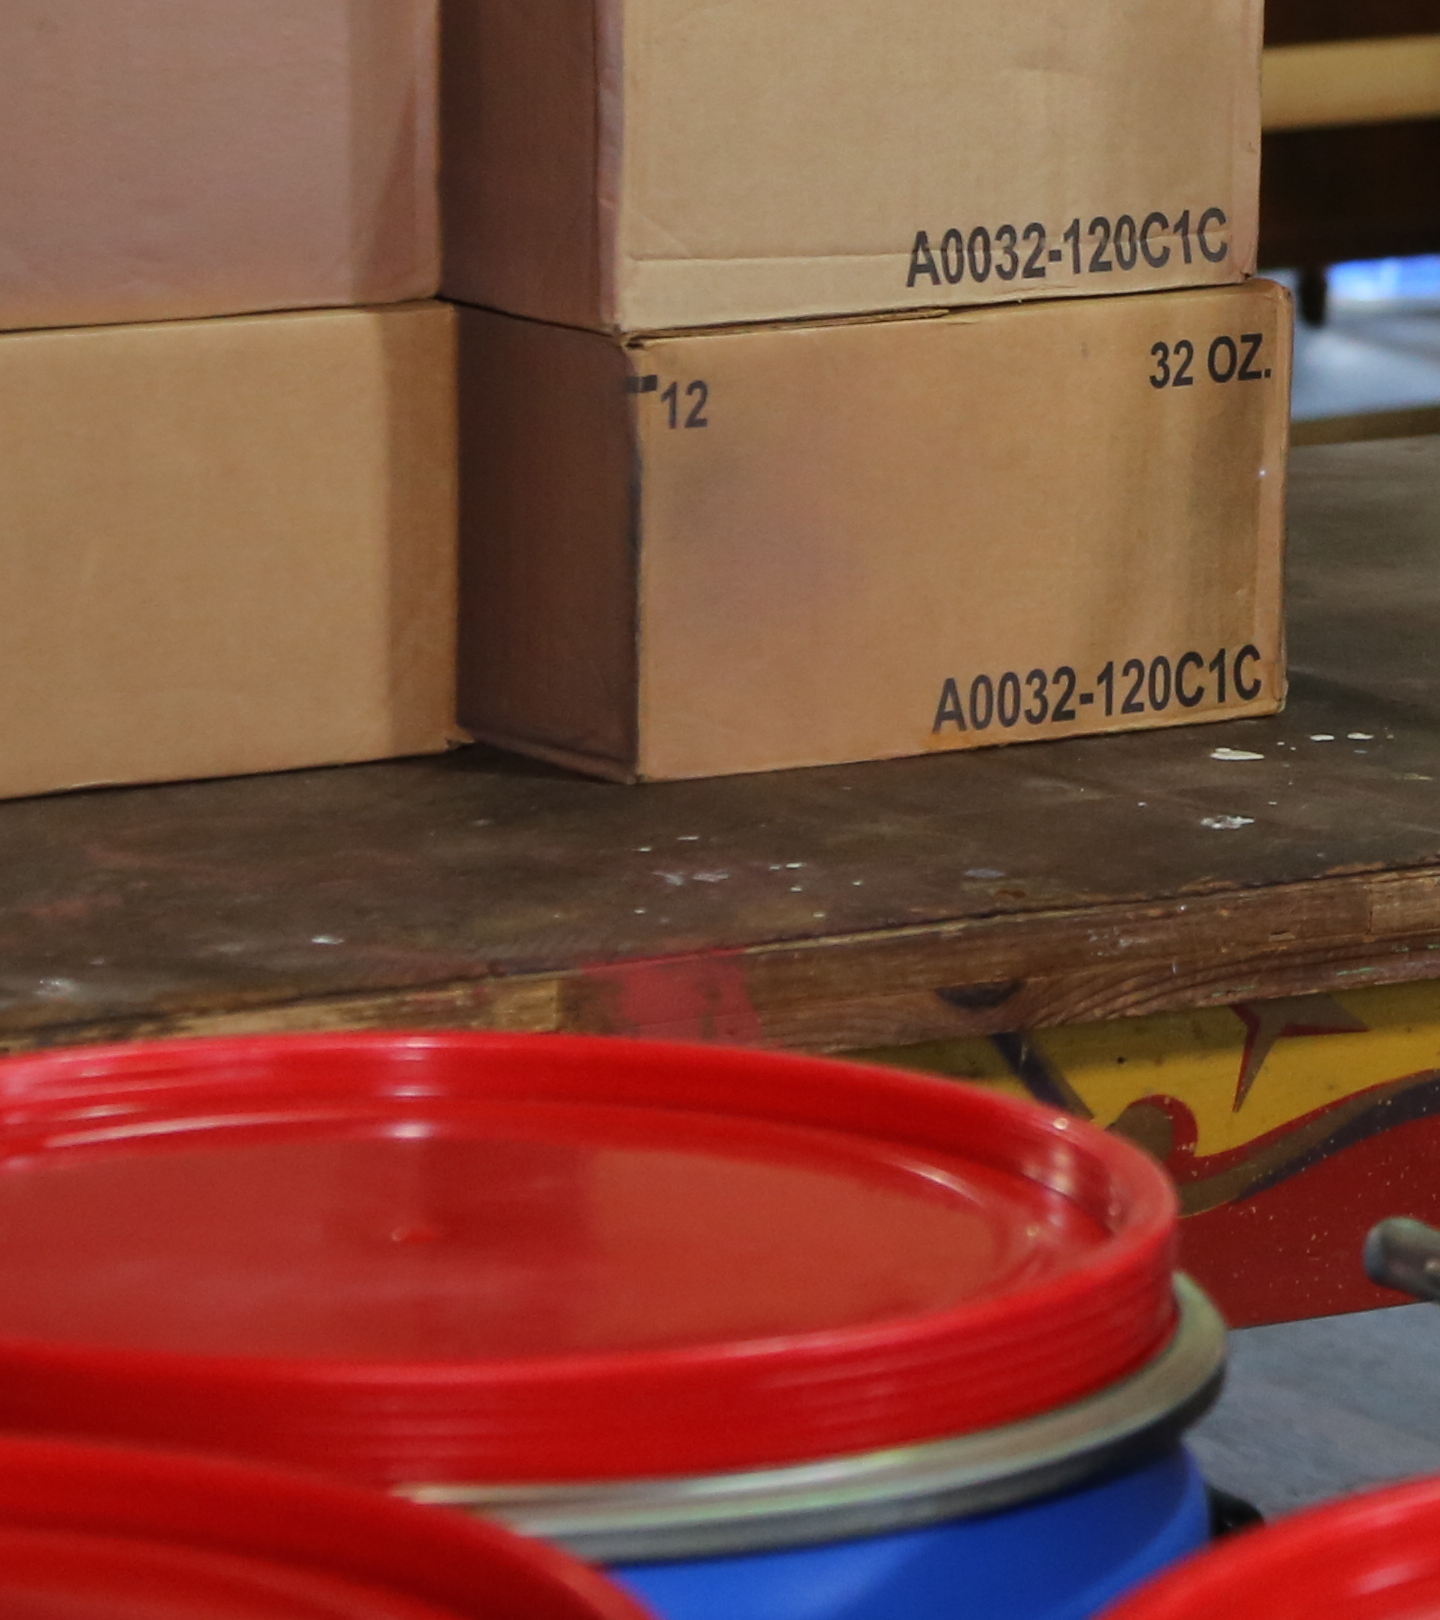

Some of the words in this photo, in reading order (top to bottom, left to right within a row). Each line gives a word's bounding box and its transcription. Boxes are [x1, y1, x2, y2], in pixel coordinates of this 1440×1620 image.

[906, 207, 1229, 288] A0032-120C1C
[1149, 340, 1194, 390] 32
[1207, 333, 1272, 383] OZ.
[661, 380, 709, 430] 12
[932, 644, 1262, 734] A0032-120C1C
